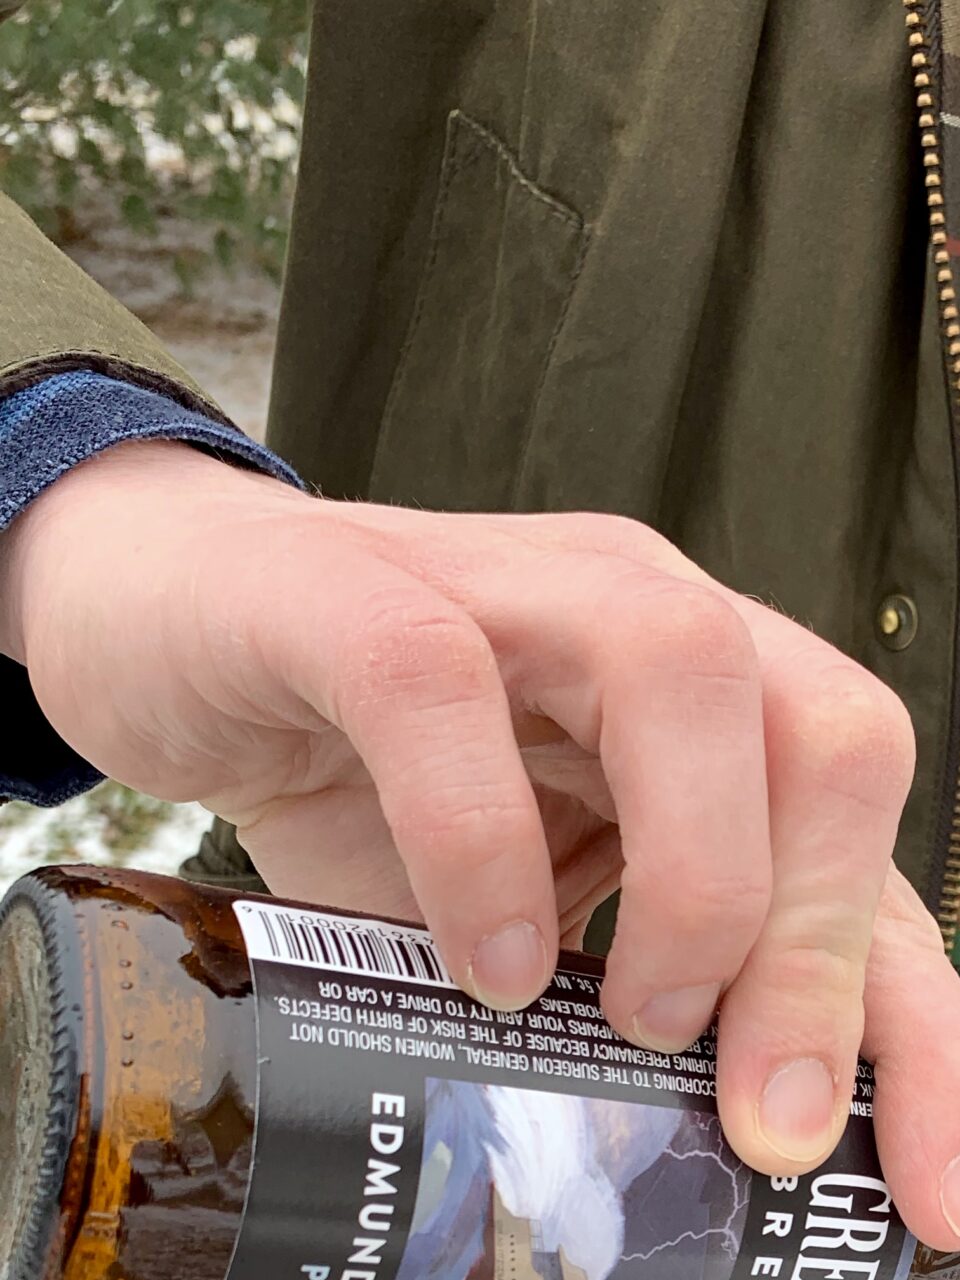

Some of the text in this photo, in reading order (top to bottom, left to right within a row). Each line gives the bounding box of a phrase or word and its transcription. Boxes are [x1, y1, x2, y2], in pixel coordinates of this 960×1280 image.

[286, 913, 361, 934] 20001
[318, 981, 342, 999] OR
[346, 985, 377, 1005] CAR
[381, 990, 393, 1006] A
[274, 996, 352, 1023] DEFECTS.
[397, 993, 441, 1014] DRIVE
[445, 1002, 467, 1018] TO
[539, 997, 605, 1020] ROBLEMS
[356, 1008, 403, 1030] BIRTH
[408, 1016, 428, 1034] OF
[430, 1019, 465, 1039] RISK
[527, 1013, 566, 1032] YOUR
[470, 1025, 501, 1045] THE
[503, 1030, 522, 1047] OF
[525, 1033, 590, 1057] BECAUSE
[290, 1022, 717, 1097] CCORDING TO THE SURGEON GENERAL, WOMEN SHOULD NOT
[593, 1044, 671, 1069] PREGNANCY
